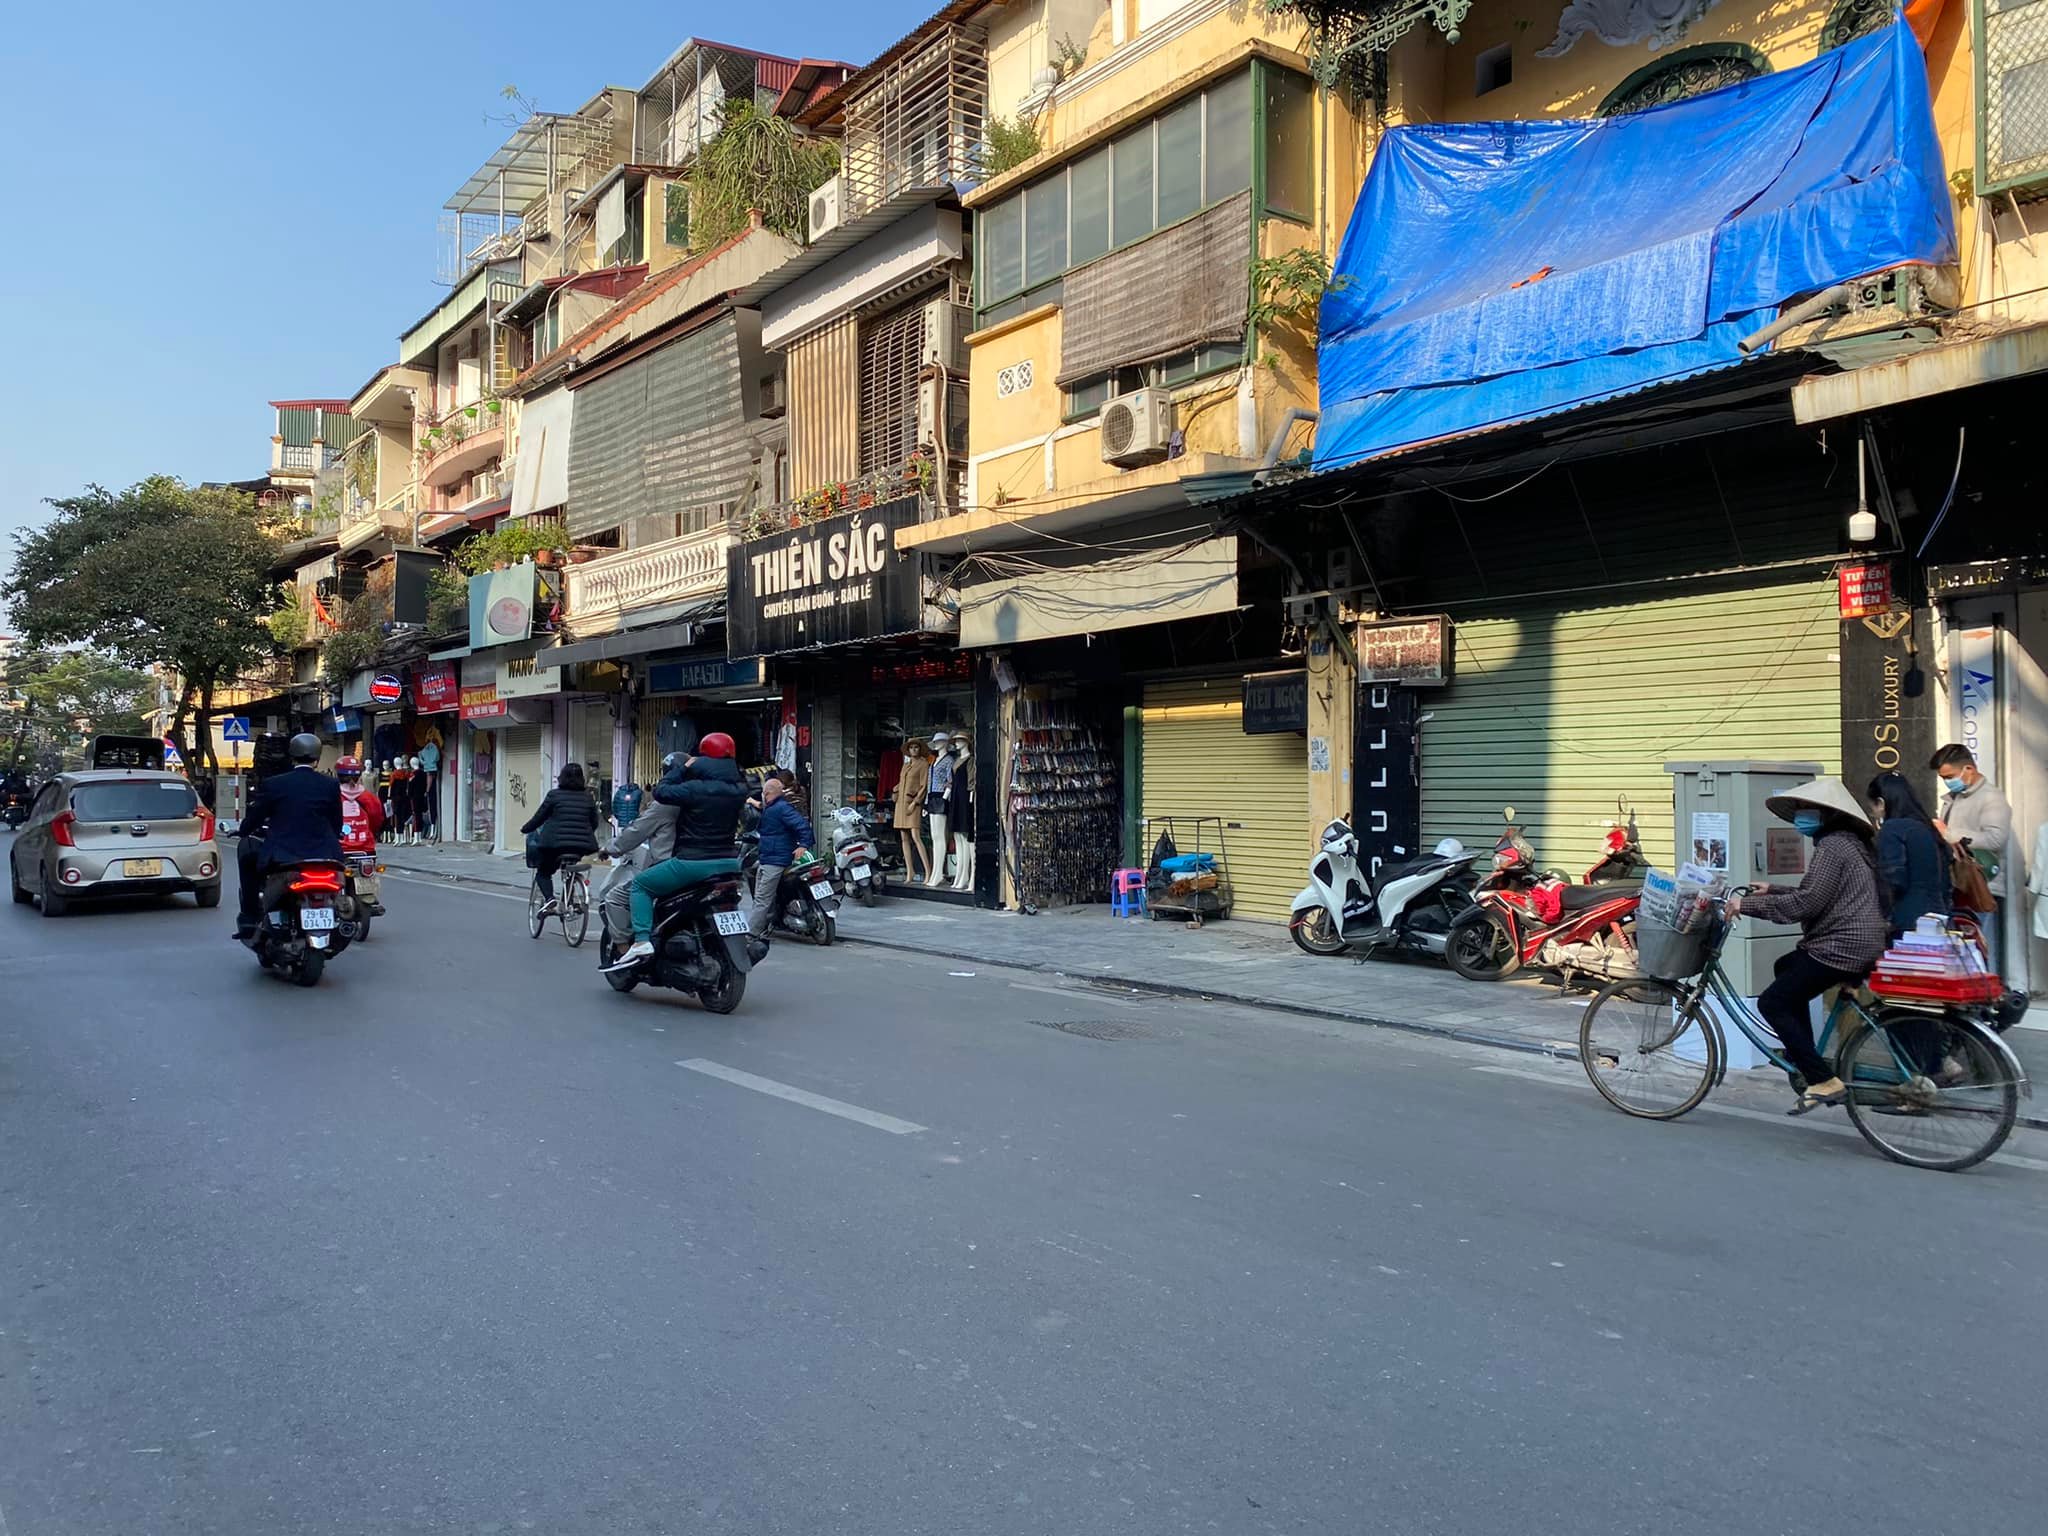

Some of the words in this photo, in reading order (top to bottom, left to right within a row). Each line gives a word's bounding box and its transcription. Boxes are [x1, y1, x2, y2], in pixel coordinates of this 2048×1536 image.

[751, 537, 822, 597] THIÊN
[828, 514, 885, 580] SẮC
[763, 598, 793, 619] CHUYÊN
[1883, 655, 1900, 719] LUXURY
